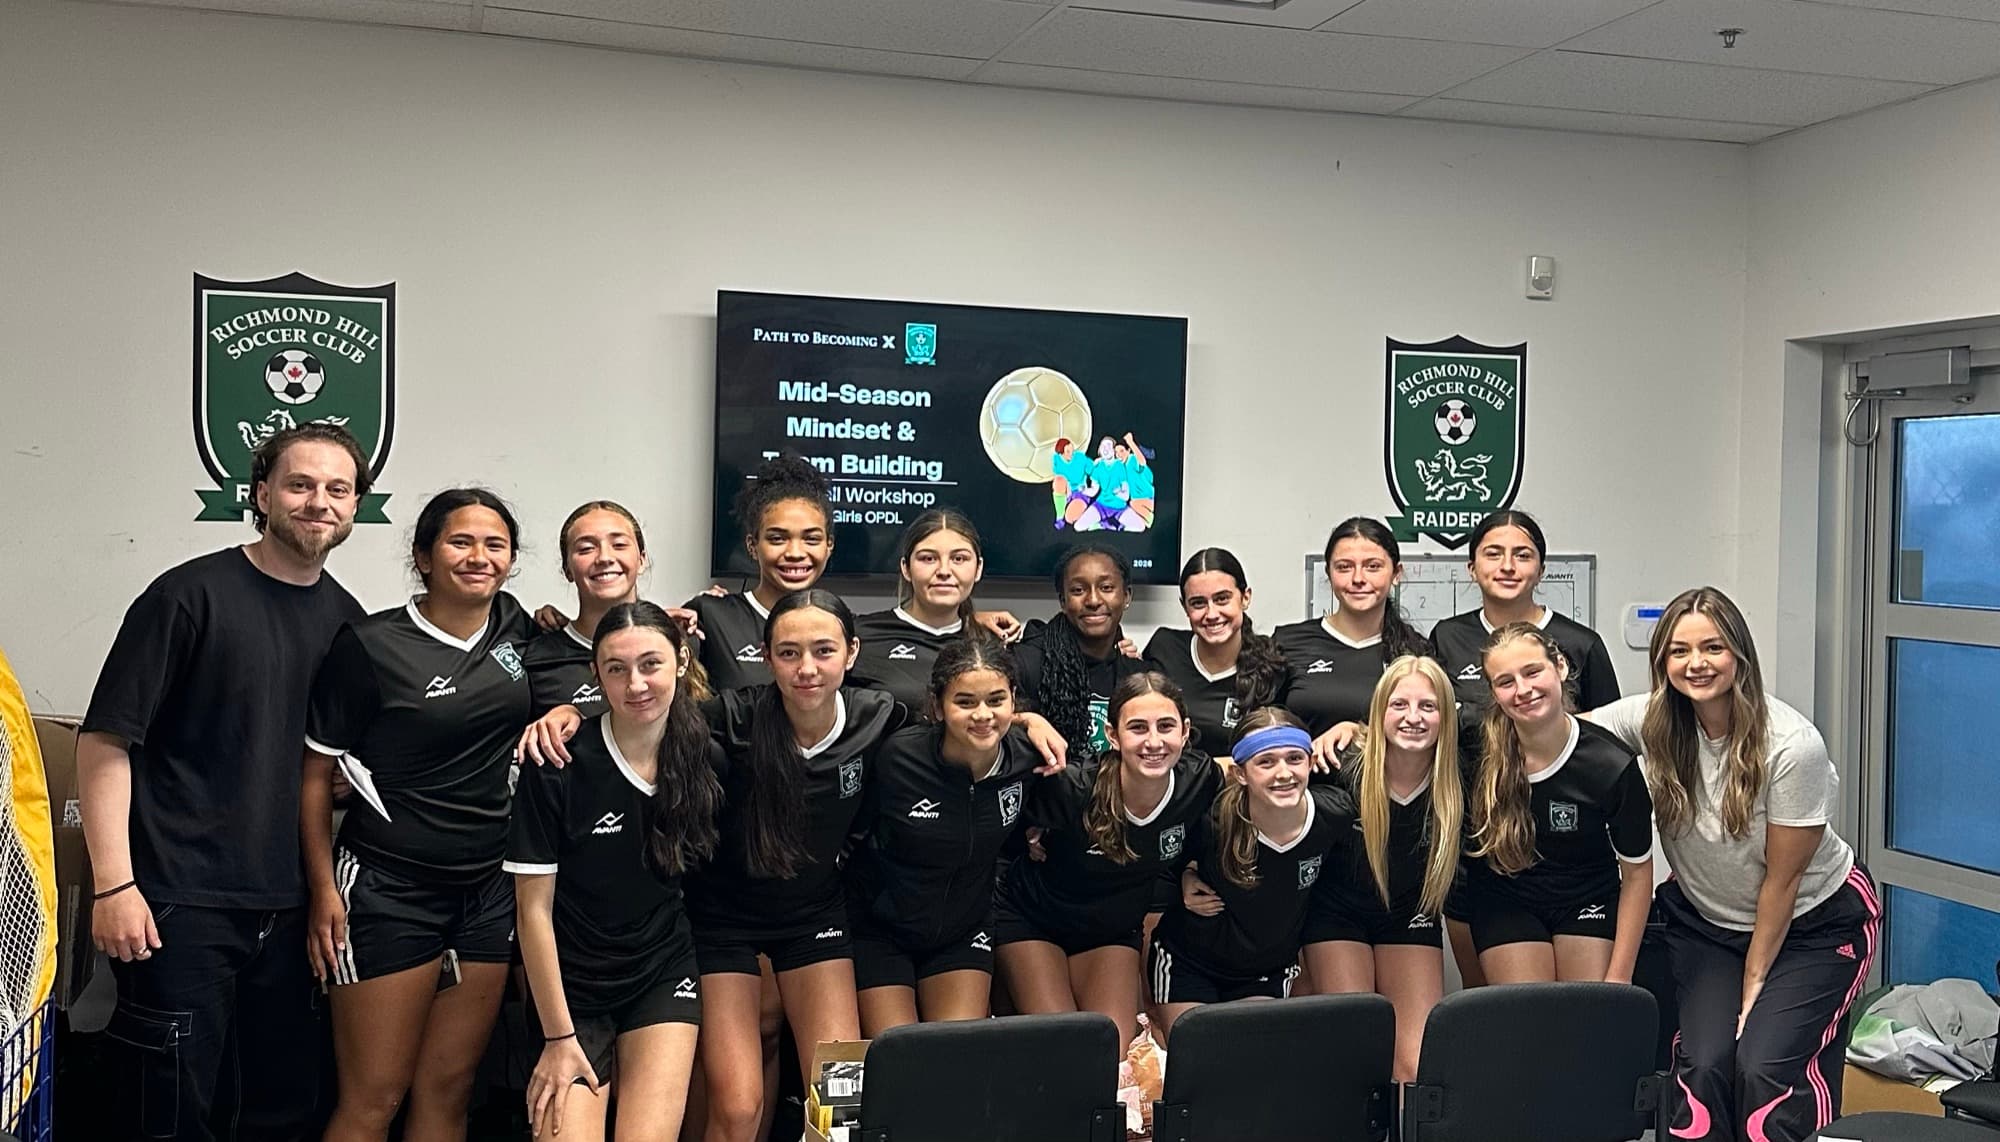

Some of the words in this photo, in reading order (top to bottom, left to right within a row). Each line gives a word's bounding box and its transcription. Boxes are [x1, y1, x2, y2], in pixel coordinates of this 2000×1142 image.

[209, 306, 331, 344] RICHMOND
[335, 315, 381, 351] HILL
[226, 328, 308, 361] SOCCER
[312, 331, 367, 365] CLUB
[1397, 363, 1482, 396] RICHMOND
[1484, 369, 1516, 400] HILL
[1407, 381, 1465, 409] SOCCER
[1468, 384, 1506, 411] CLUB
[786, 416, 892, 441] Mindset
[897, 421, 916, 442] &
[841, 454, 943, 482] Building
[845, 487, 936, 509] Workshop
[833, 509, 863, 525] Girls
[864, 511, 903, 525] OPDL
[1413, 511, 1490, 528] RAIDER
[425, 686, 456, 698] AVANTI
[571, 694, 602, 705] AVANTI
[908, 810, 939, 819] AVANTI
[591, 824, 622, 835] AVANTI
[1576, 913, 1606, 921] AVANTI
[815, 930, 843, 940] AVANTI
